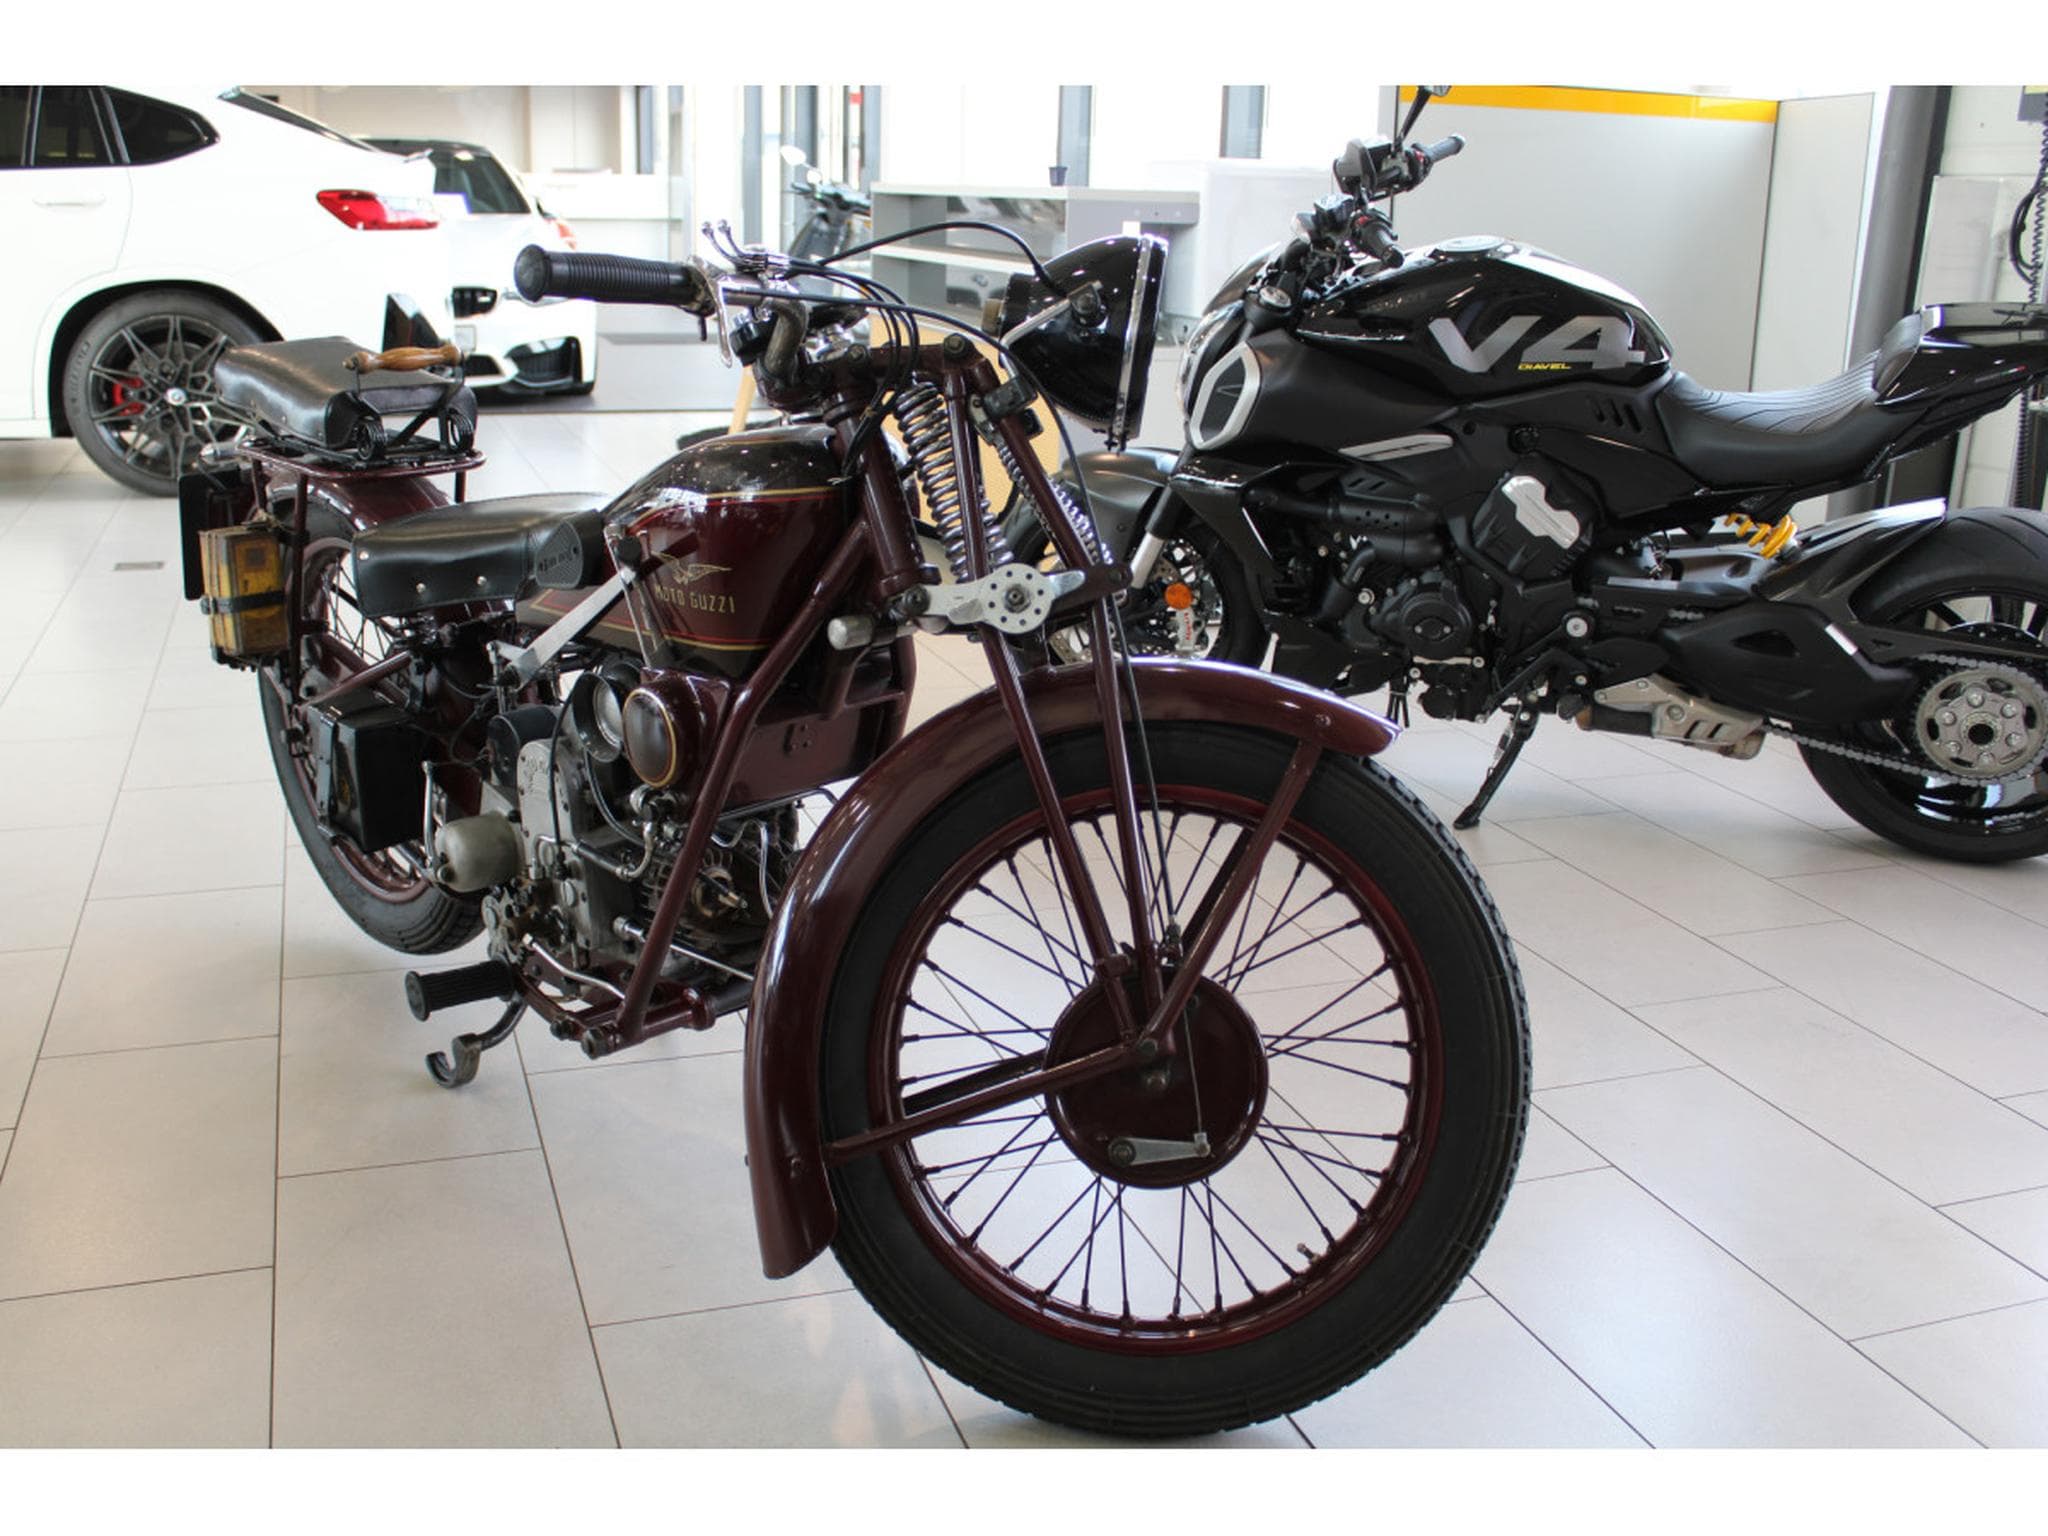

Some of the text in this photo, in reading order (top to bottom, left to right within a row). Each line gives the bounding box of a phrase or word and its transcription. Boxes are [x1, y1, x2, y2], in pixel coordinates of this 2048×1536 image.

[1428, 315, 1646, 373] V4
[1518, 362, 1571, 370] DIAVEL
[655, 585, 735, 613] MOTO GUZZI
